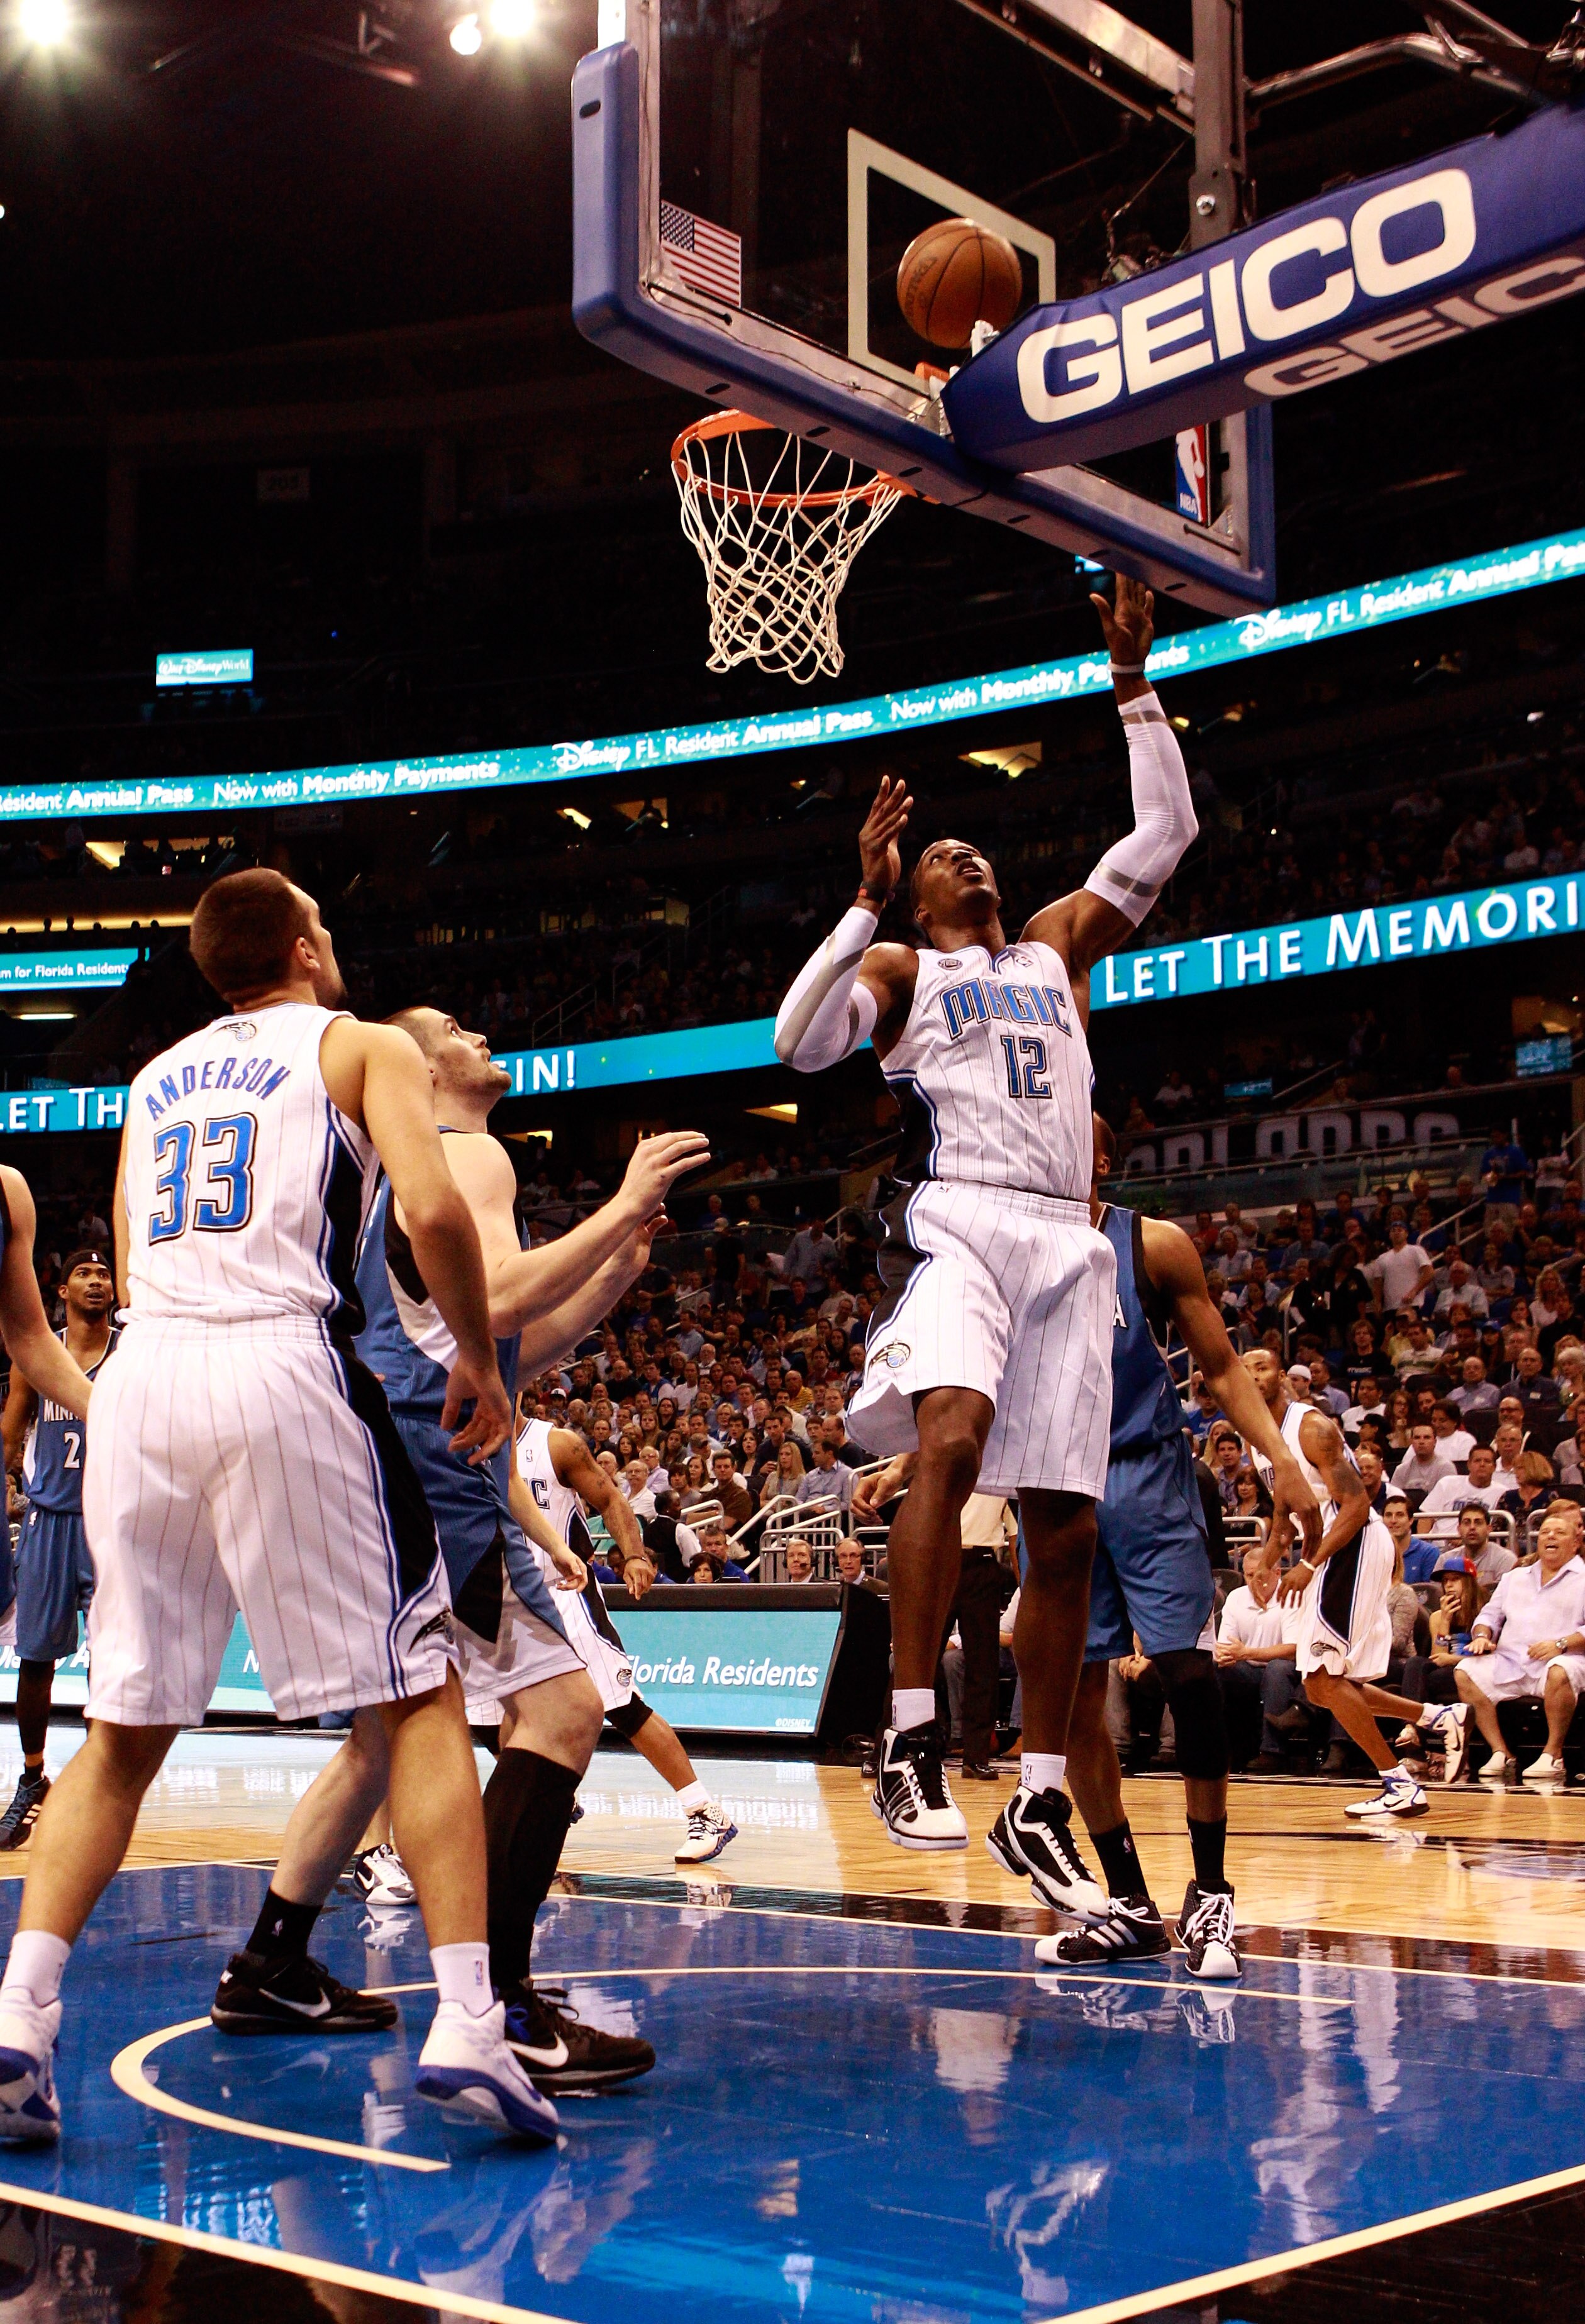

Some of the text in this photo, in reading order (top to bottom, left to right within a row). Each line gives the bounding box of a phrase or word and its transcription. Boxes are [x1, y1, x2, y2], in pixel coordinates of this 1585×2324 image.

[1016, 168, 1476, 423] GEICO
[1234, 608, 1321, 653] Disney
[1327, 600, 1354, 627] FL
[1360, 580, 1445, 617] Resident
[1448, 550, 1540, 595] Annual
[552, 741, 631, 772] Disney
[635, 739, 659, 760] FL
[666, 731, 738, 755] Resident
[742, 715, 821, 745] Annual
[826, 709, 873, 734] Pass
[891, 696, 935, 721] Now
[940, 687, 977, 711] with
[981, 668, 1074, 704] Monthly
[67, 787, 142, 808] Annual
[147, 785, 194, 804] Pass
[214, 782, 257, 802] Now
[262, 778, 298, 798] with
[303, 769, 389, 794] Monthly
[394, 761, 499, 790] Payments
[14, 965, 32, 978] for
[35, 963, 74, 978] Florida
[1105, 880, 1579, 1003] LET THE MEMORI
[940, 977, 1072, 1041] MAGIC
[145, 1057, 291, 1122] ANDERSON
[491, 1050, 575, 1093] IN!
[1000, 1034, 1052, 1099] 12
[0, 1087, 123, 1130] ET TH
[148, 1111, 258, 1247] 33
[702, 1656, 820, 1688] Residents
